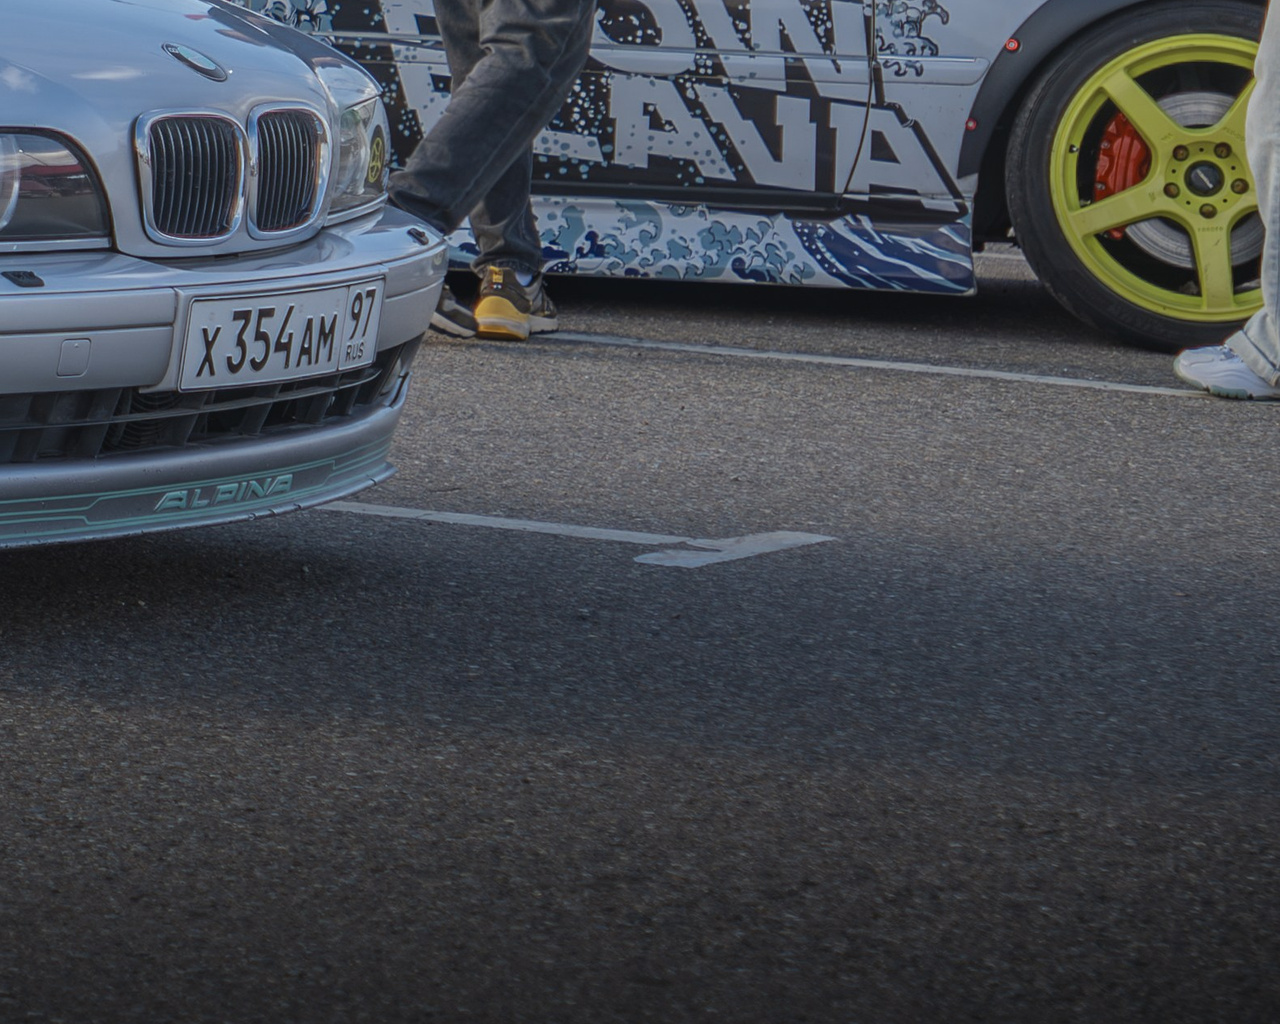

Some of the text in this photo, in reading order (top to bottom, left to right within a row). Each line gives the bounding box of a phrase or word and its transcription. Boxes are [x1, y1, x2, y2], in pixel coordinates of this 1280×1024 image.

[348, 287, 377, 340] 97
[345, 342, 365, 362] RUS
[154, 473, 293, 513] ALPINA
